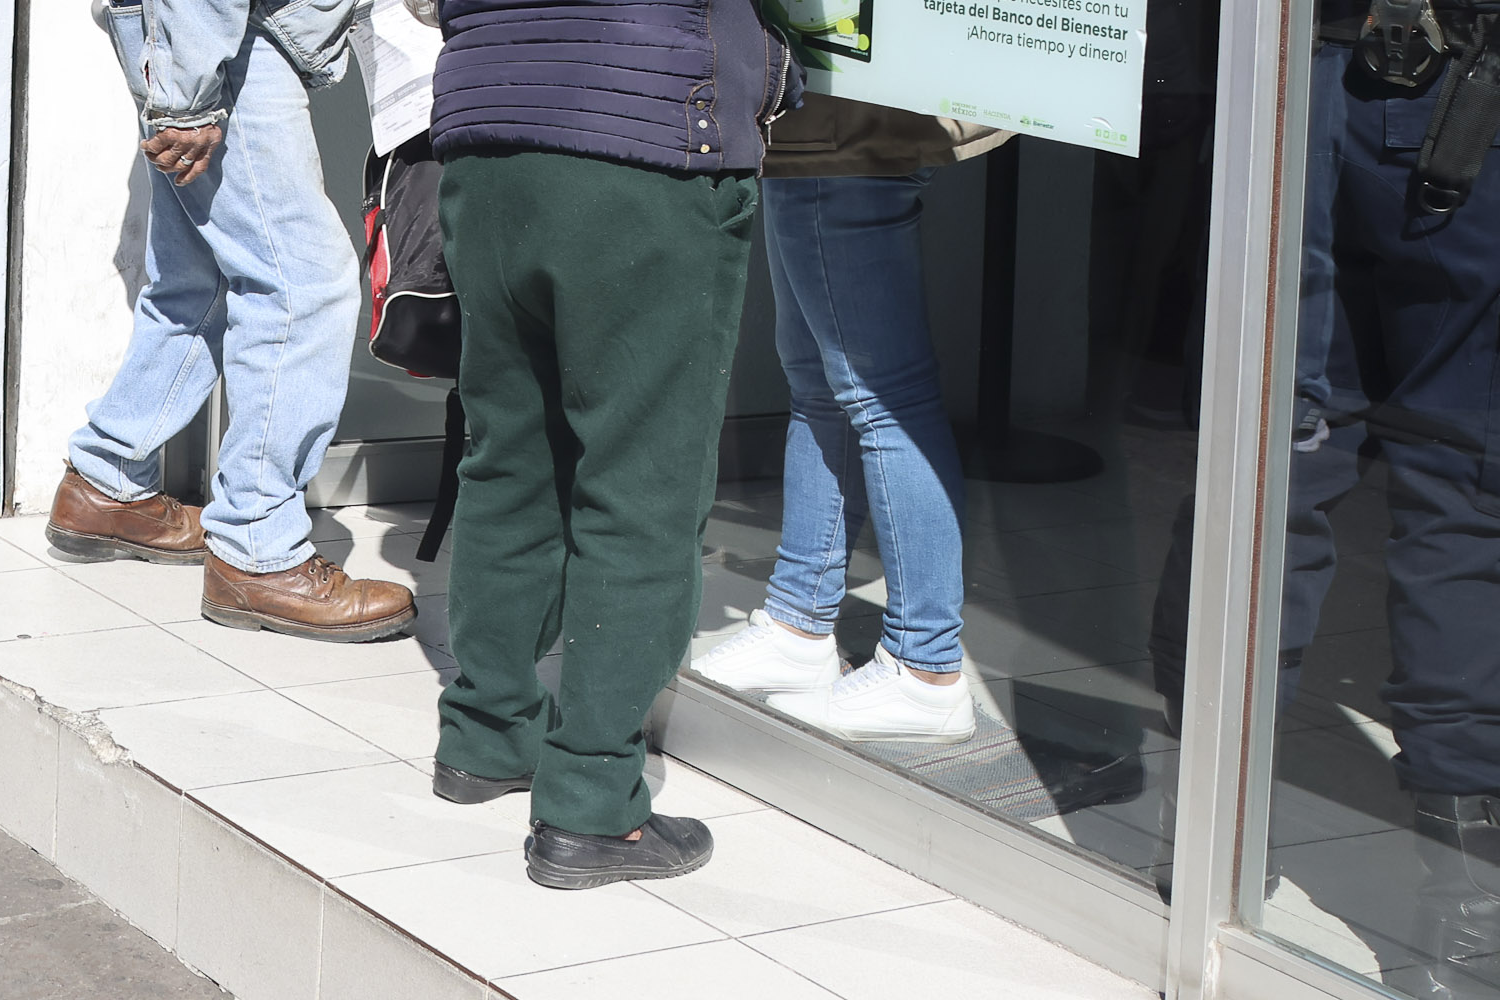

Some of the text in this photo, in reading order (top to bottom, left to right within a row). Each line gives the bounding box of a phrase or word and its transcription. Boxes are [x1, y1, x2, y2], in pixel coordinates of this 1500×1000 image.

[968, 2, 989, 20] del
[992, 7, 1033, 26] Banco
[1036, 14, 1057, 30] del
[1061, 18, 1128, 41] Bienestar
[1085, 0, 1110, 16] con
[1114, 3, 1129, 18] tu
[967, 25, 1127, 64] ¡Ahorra tiempo y dinero!
[951, 106, 977, 118] MÉXICO
